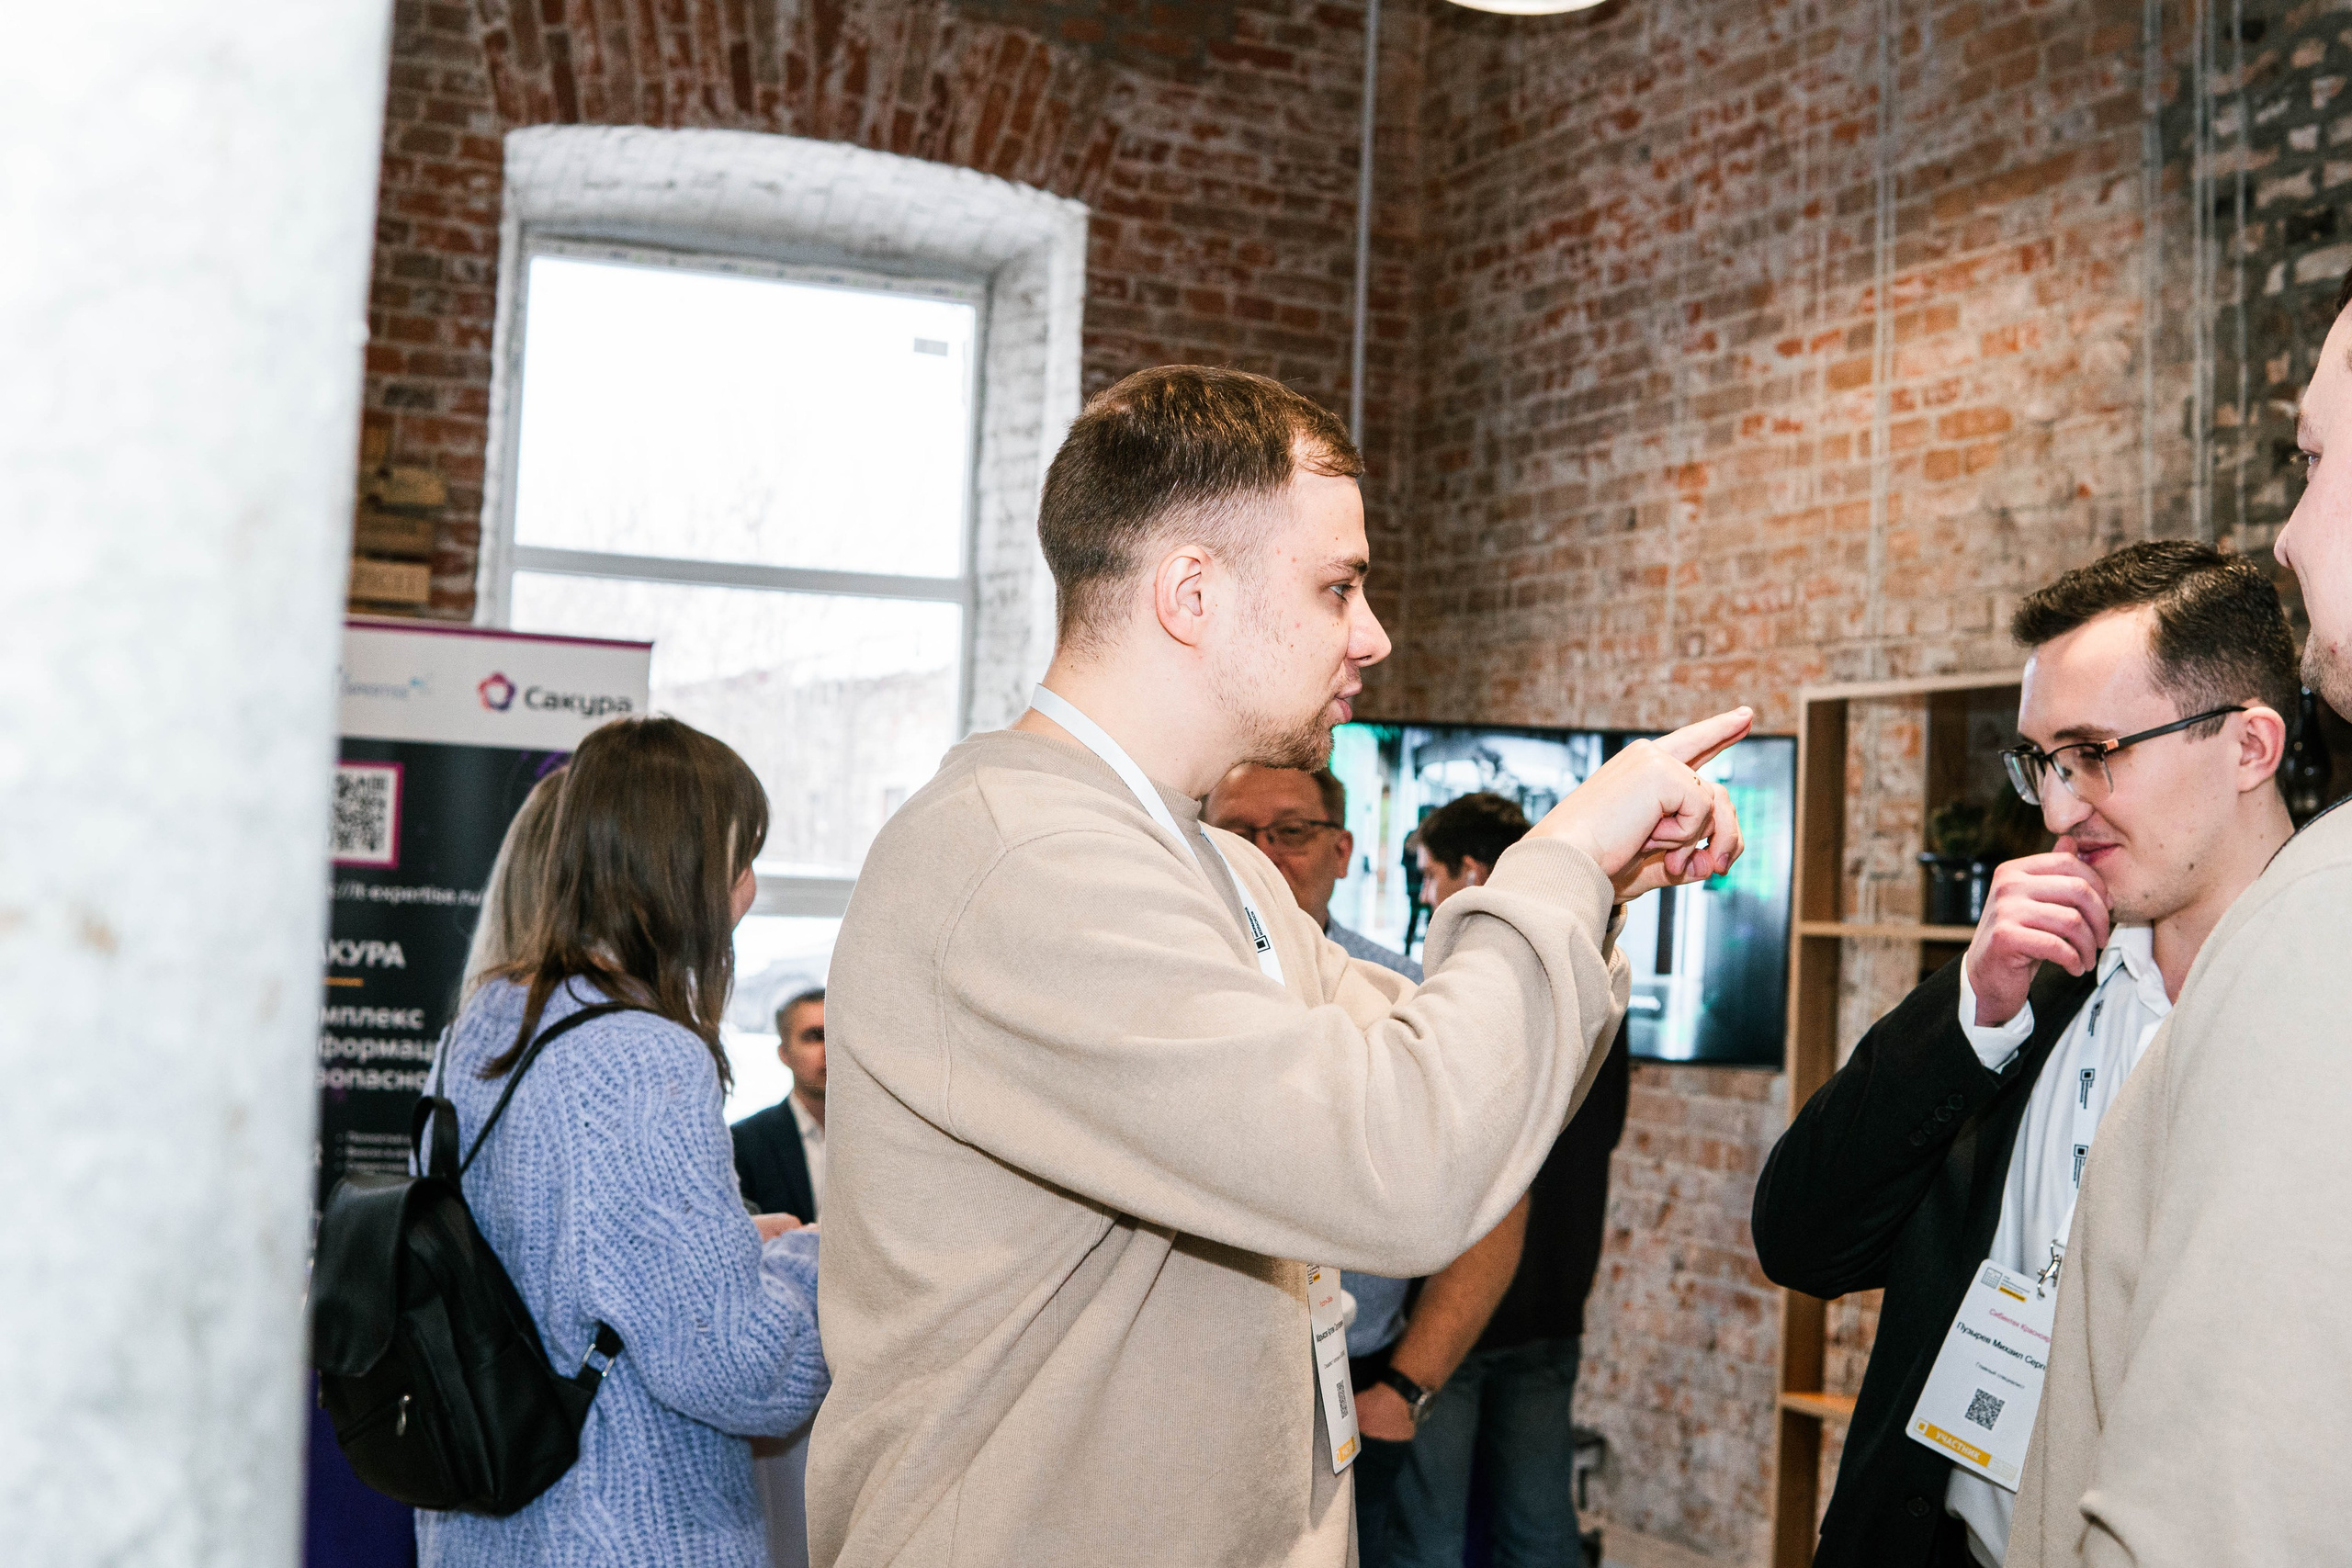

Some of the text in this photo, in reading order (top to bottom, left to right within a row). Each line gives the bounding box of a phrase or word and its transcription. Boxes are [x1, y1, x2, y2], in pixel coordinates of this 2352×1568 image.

[523, 684, 633, 718] Сакура
[322, 938, 406, 969] КУРА
[1956, 1321, 1992, 1344] Пузырев
[1992, 1338, 2024, 1360] Михаил
[1935, 1430, 1982, 1461] УЧАСТНИК
